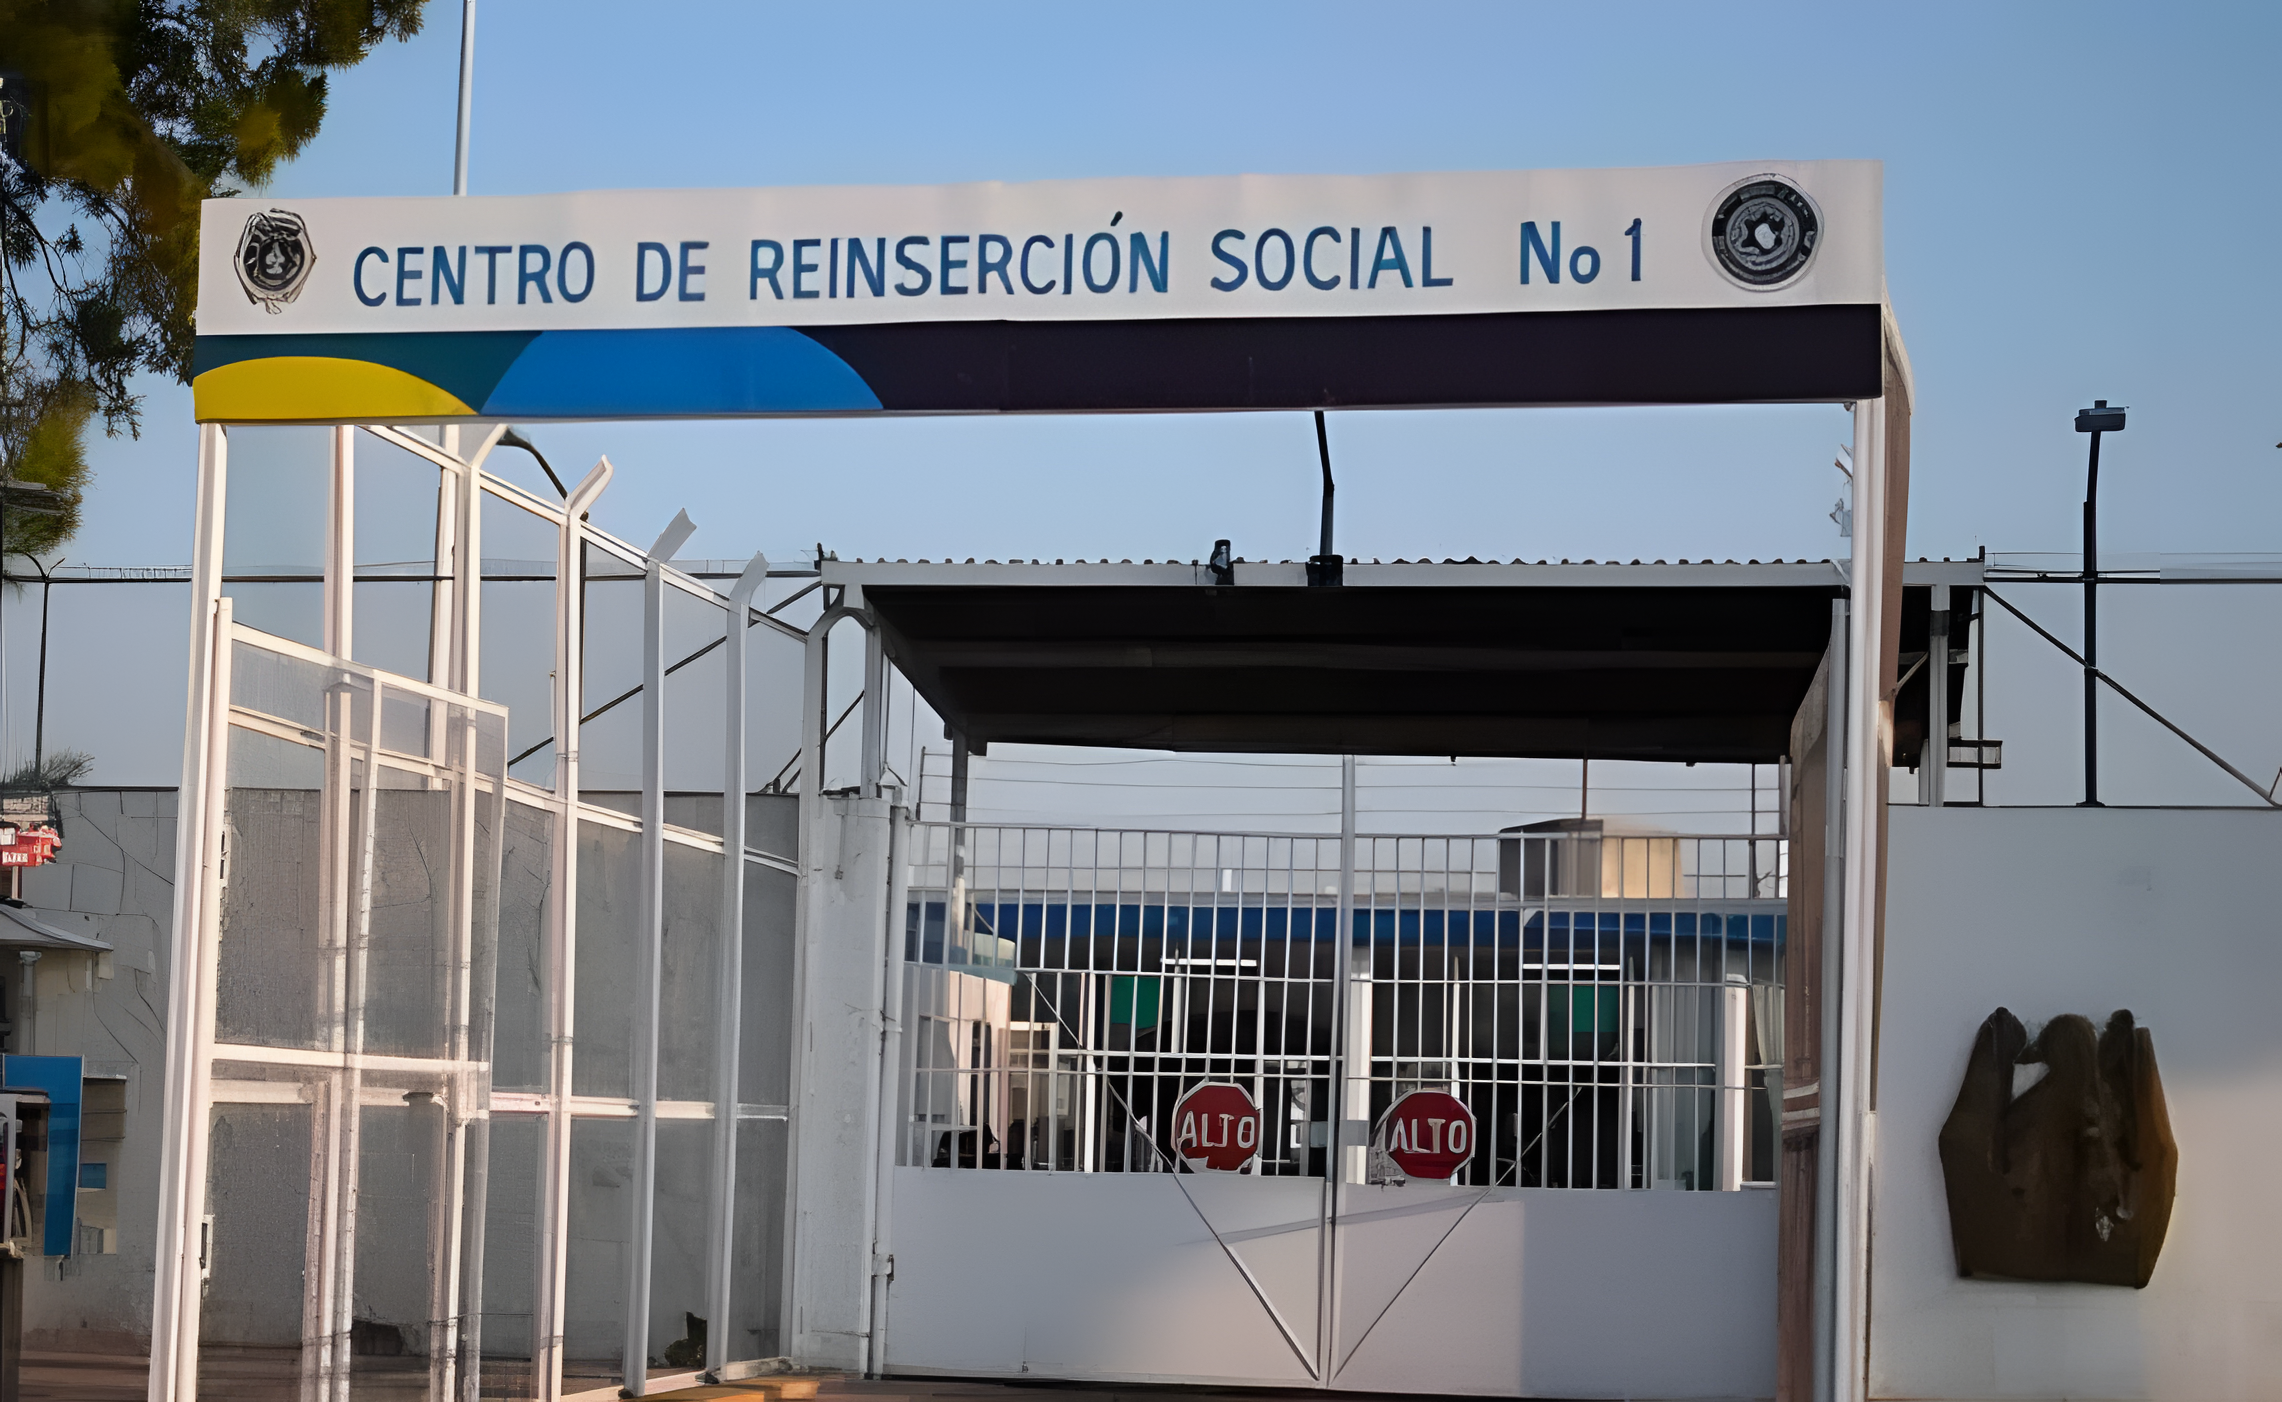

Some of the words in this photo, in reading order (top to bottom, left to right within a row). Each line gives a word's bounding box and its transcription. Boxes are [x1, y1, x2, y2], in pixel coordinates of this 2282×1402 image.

[353, 241, 595, 307] CENTRO
[635, 241, 710, 304] DE
[749, 211, 1170, 301] REINSERCIÓN
[1210, 226, 1455, 293] SOCIAL
[1520, 220, 1601, 285] No
[1624, 217, 1643, 282] 1
[1178, 1110, 1255, 1149] ALTO
[1389, 1116, 1467, 1154] ALTO
